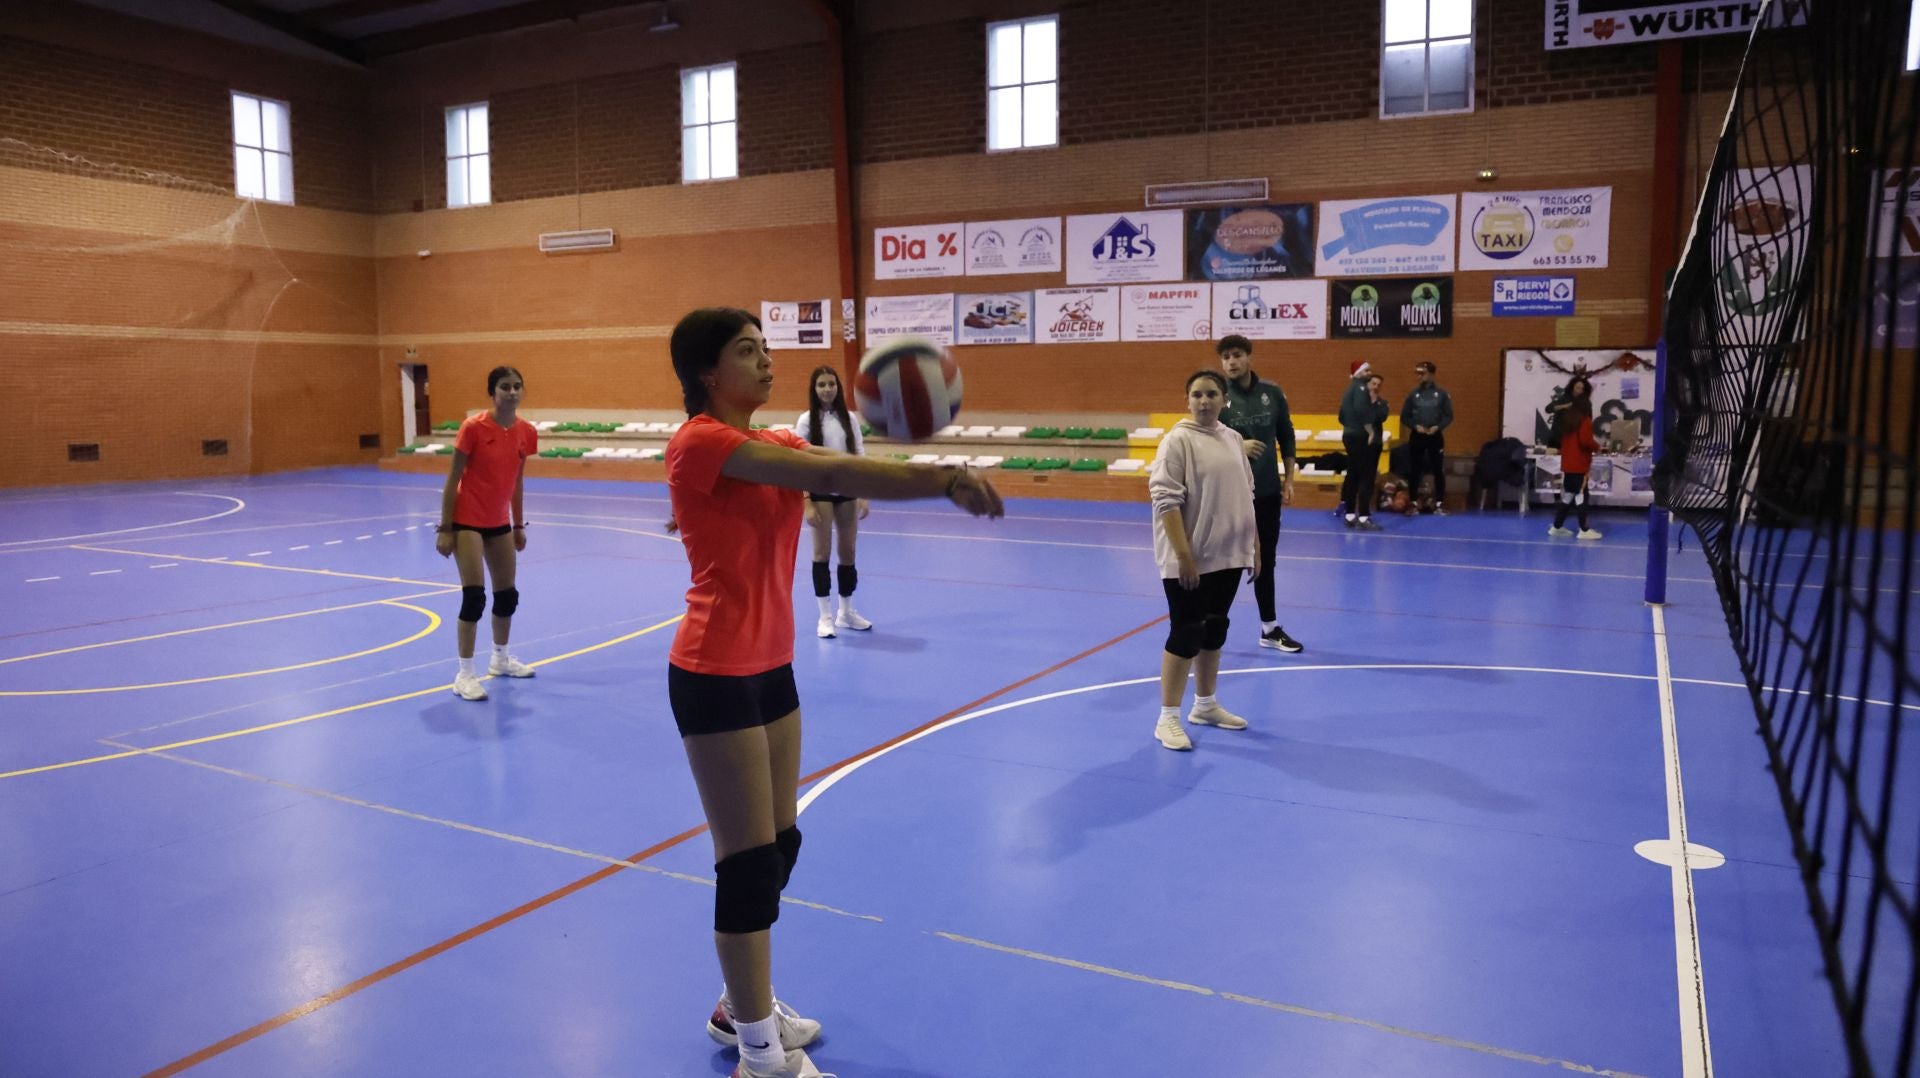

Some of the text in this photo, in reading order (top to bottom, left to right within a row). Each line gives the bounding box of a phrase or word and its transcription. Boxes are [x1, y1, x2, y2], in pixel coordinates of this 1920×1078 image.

[1553, 0, 1569, 46] RTH
[1629, 2, 1765, 37] WÜRTH
[1539, 194, 1593, 206] FRANCISCO
[1541, 205, 1591, 217] MENDOZA
[1481, 233, 1524, 248] TAXI
[882, 235, 926, 261] Dia
[1533, 255, 1596, 266] 663 53 55 79
[1496, 282, 1514, 300] S R
[1517, 281, 1550, 290] SERVI
[1517, 291, 1550, 301] RIEGOS
